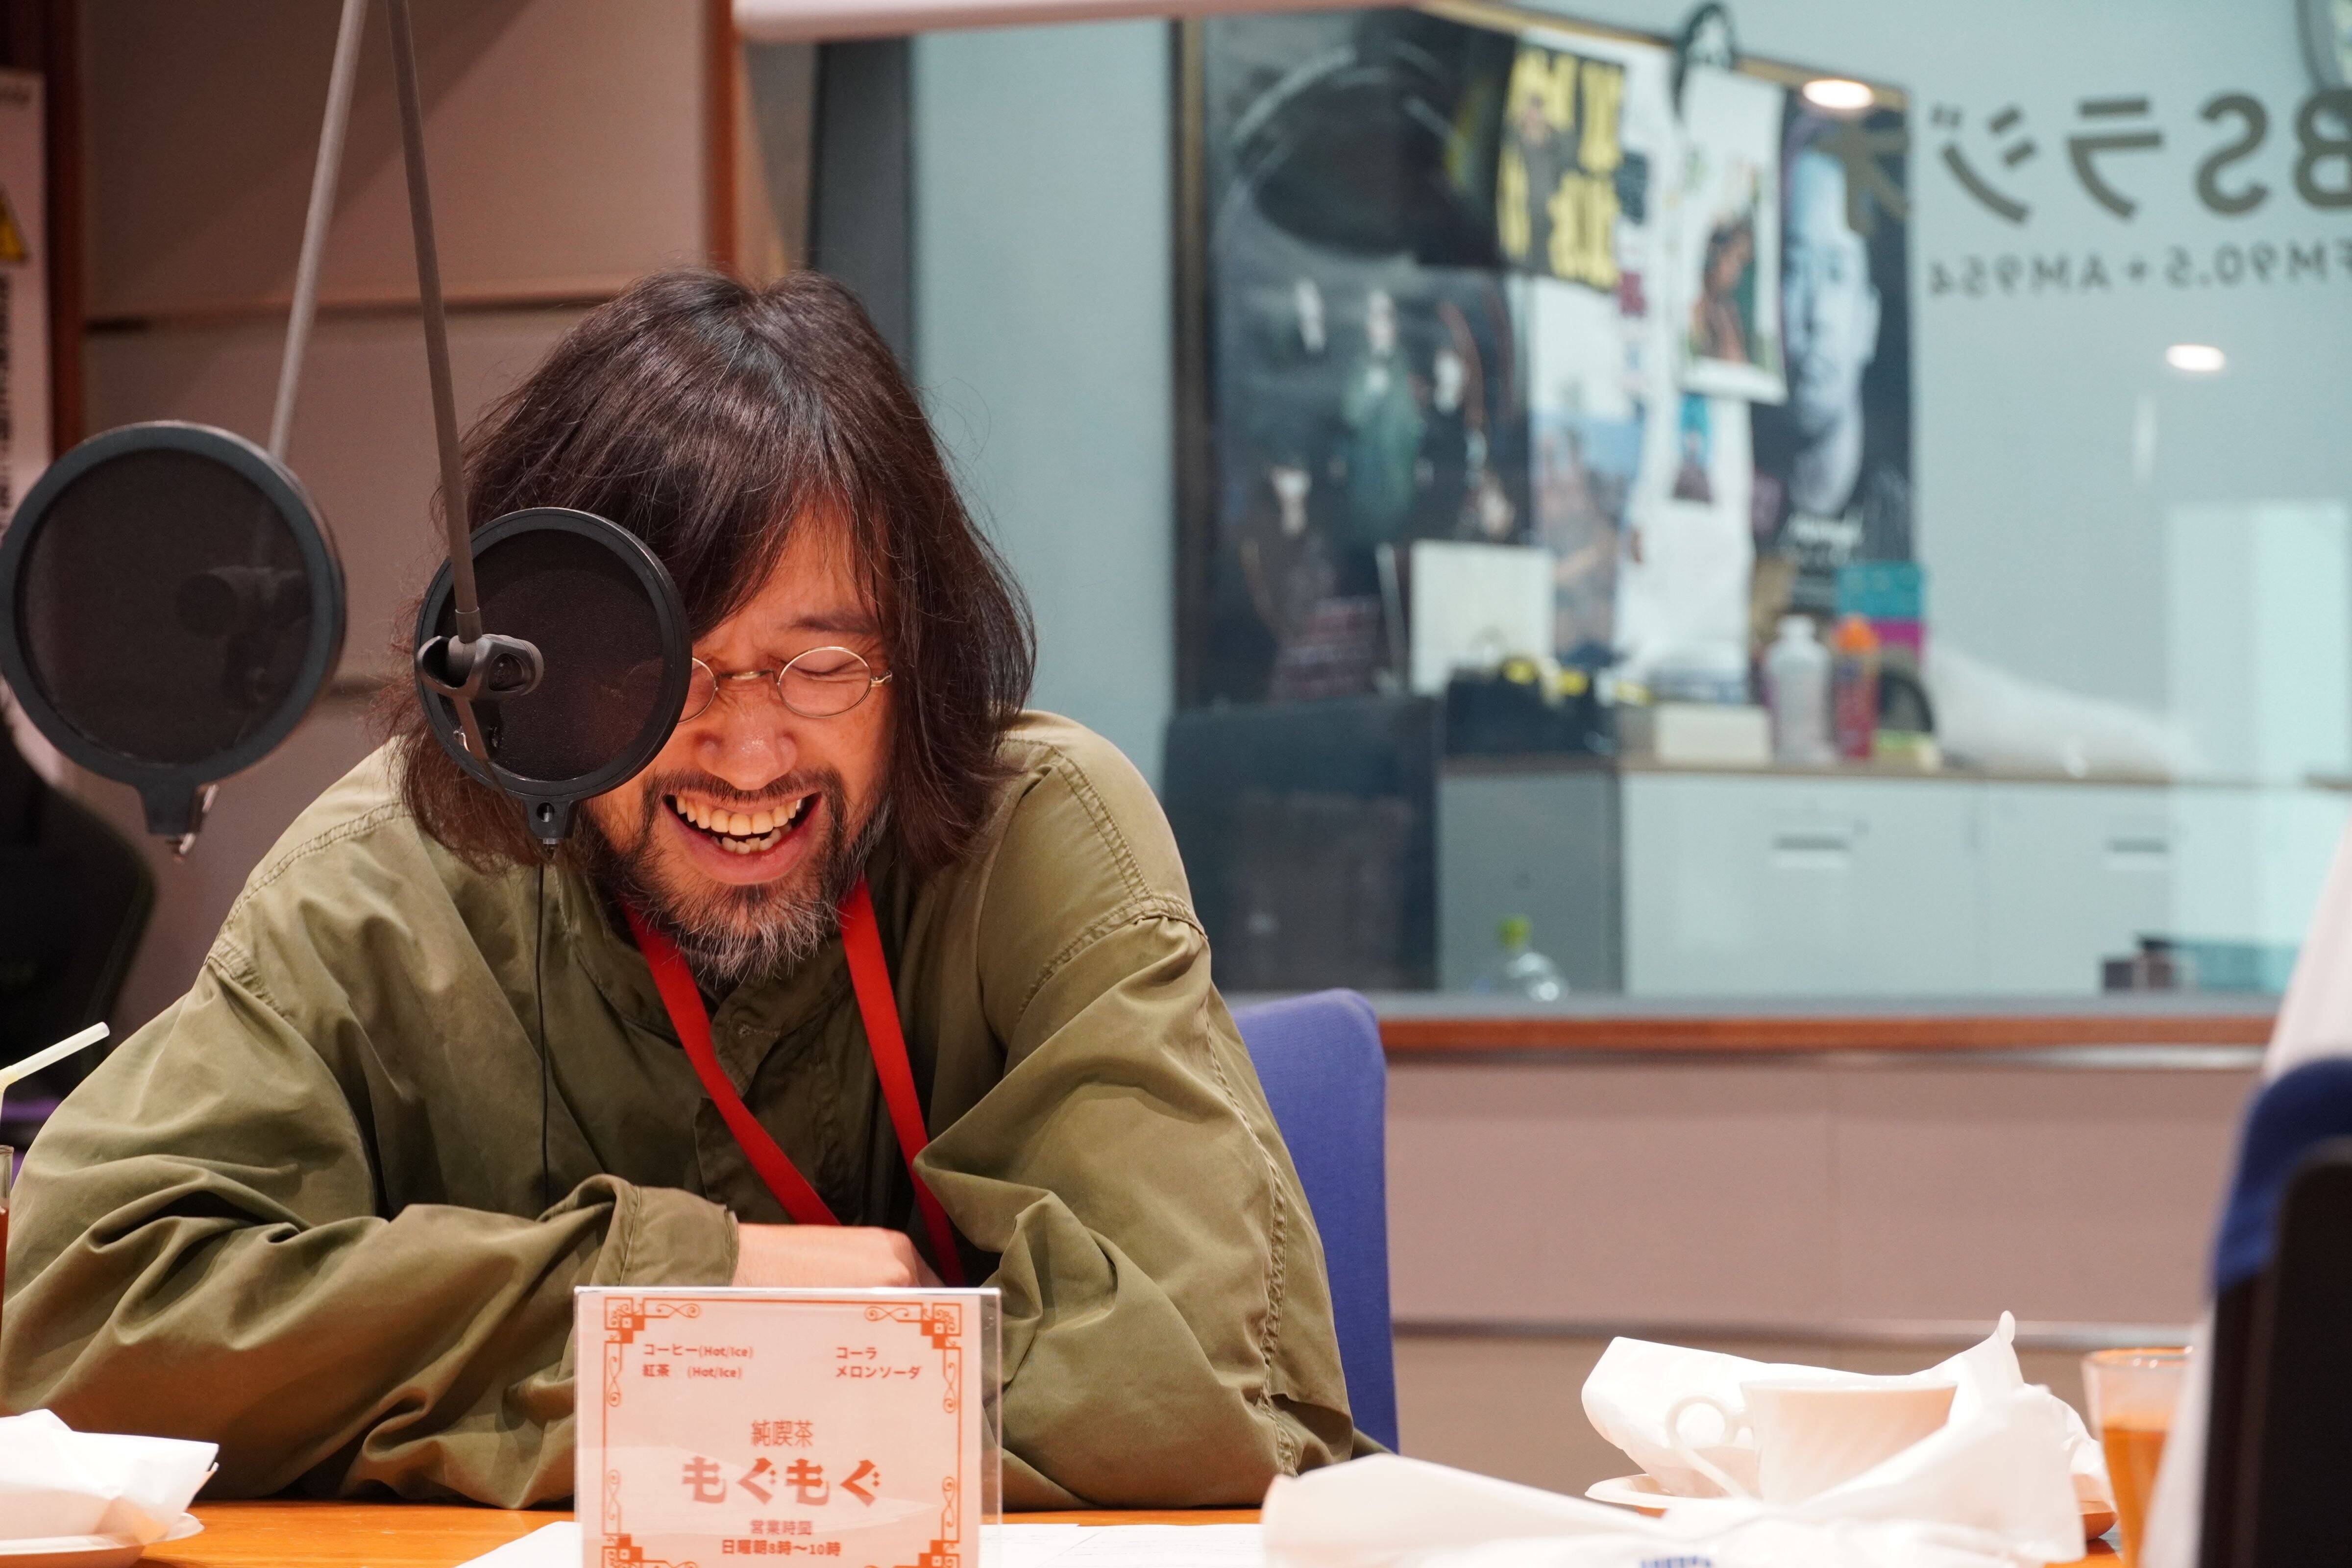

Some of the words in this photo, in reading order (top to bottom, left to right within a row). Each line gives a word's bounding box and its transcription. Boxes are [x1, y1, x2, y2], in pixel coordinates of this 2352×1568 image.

[836, 1347, 877, 1360] コーラ
[643, 1364, 669, 1377] 紅茶
[687, 1366, 742, 1379] (Hot/Ice)
[835, 1365, 922, 1379] メロンソーダ
[751, 1420, 813, 1446] 純喫茶
[682, 1456, 882, 1508] もぐもぐ
[751, 1519, 812, 1536] 営業時間
